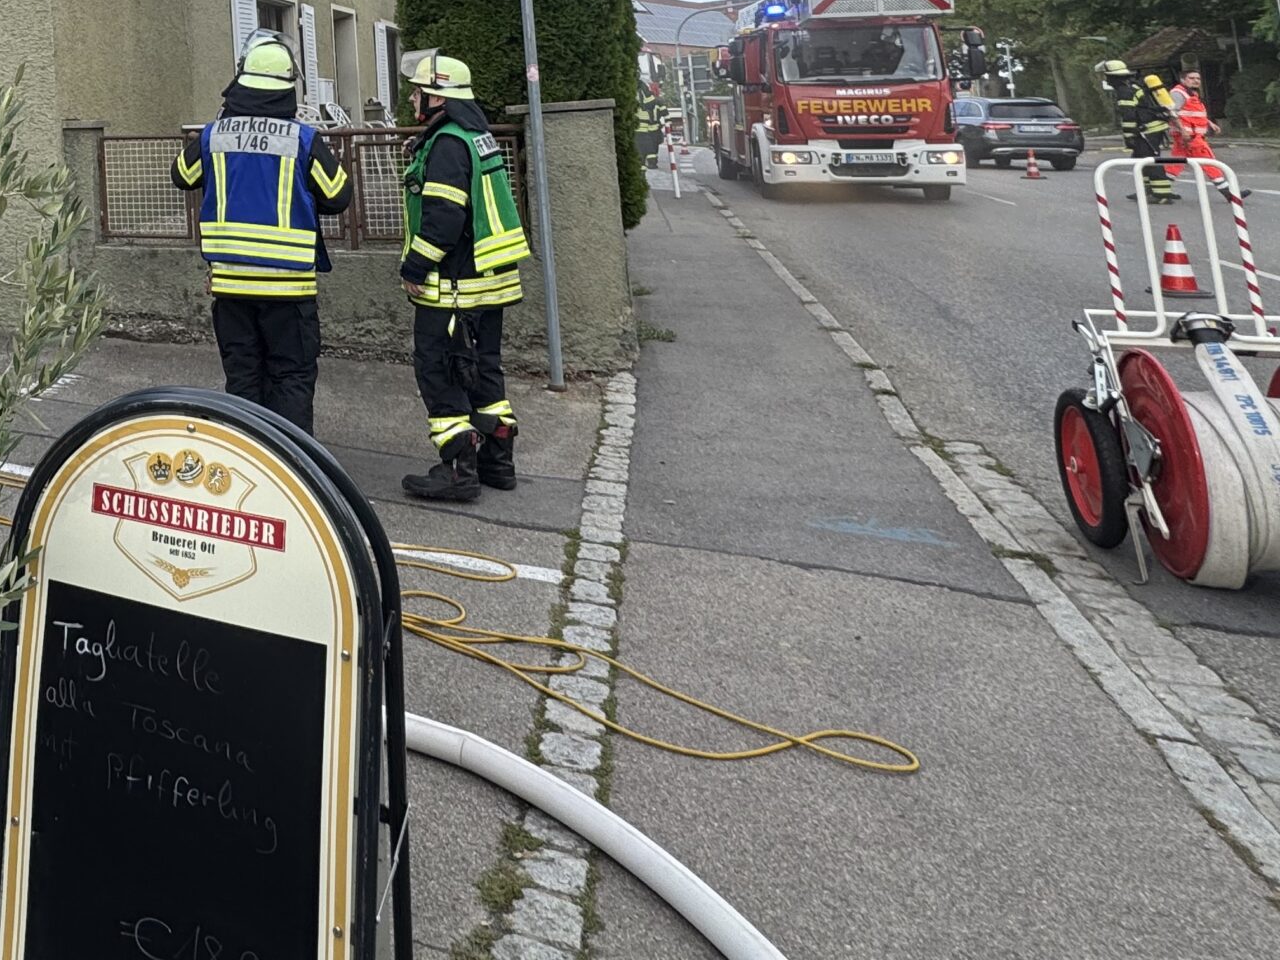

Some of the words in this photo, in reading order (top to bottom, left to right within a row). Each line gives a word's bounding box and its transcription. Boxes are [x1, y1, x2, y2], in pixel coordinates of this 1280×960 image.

[835, 87, 891, 96] MAGIRUS
[796, 98, 933, 114] FEUERWEHR
[217, 117, 292, 136] Markdorf
[836, 114, 894, 125] IVECO
[235, 134, 269, 151] 1/46
[101, 489, 276, 546] SCHUSSENRIEDER
[152, 530, 197, 551] Brauerei
[200, 541, 216, 555] Ott
[53, 619, 224, 694] Tagliatelle
[46, 678, 96, 717] alla
[121, 701, 256, 775] Toscana
